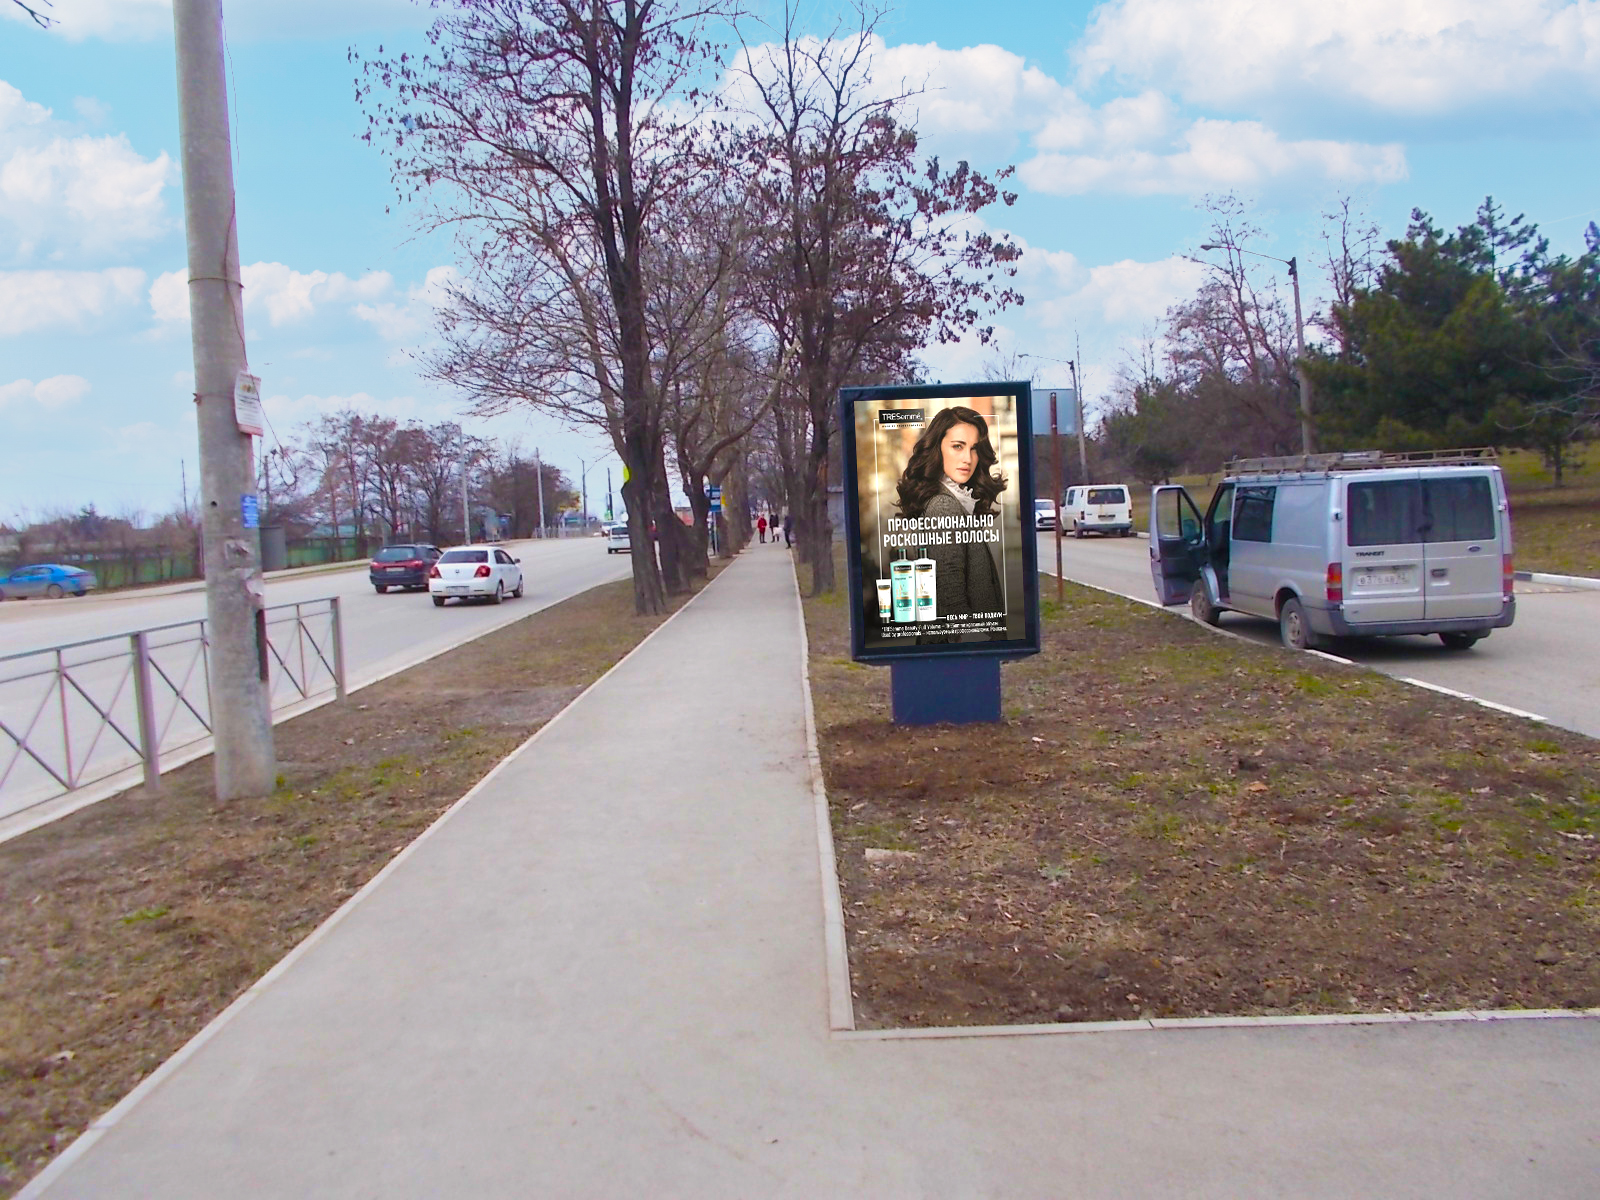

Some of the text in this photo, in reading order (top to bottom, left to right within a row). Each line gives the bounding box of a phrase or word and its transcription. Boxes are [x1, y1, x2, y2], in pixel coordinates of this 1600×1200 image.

[888, 514, 994, 532] ПРОФЕССИОНАЛЬНО
[883, 529, 1000, 548] РОСКОШНЫЕ ВОЛОСЫ
